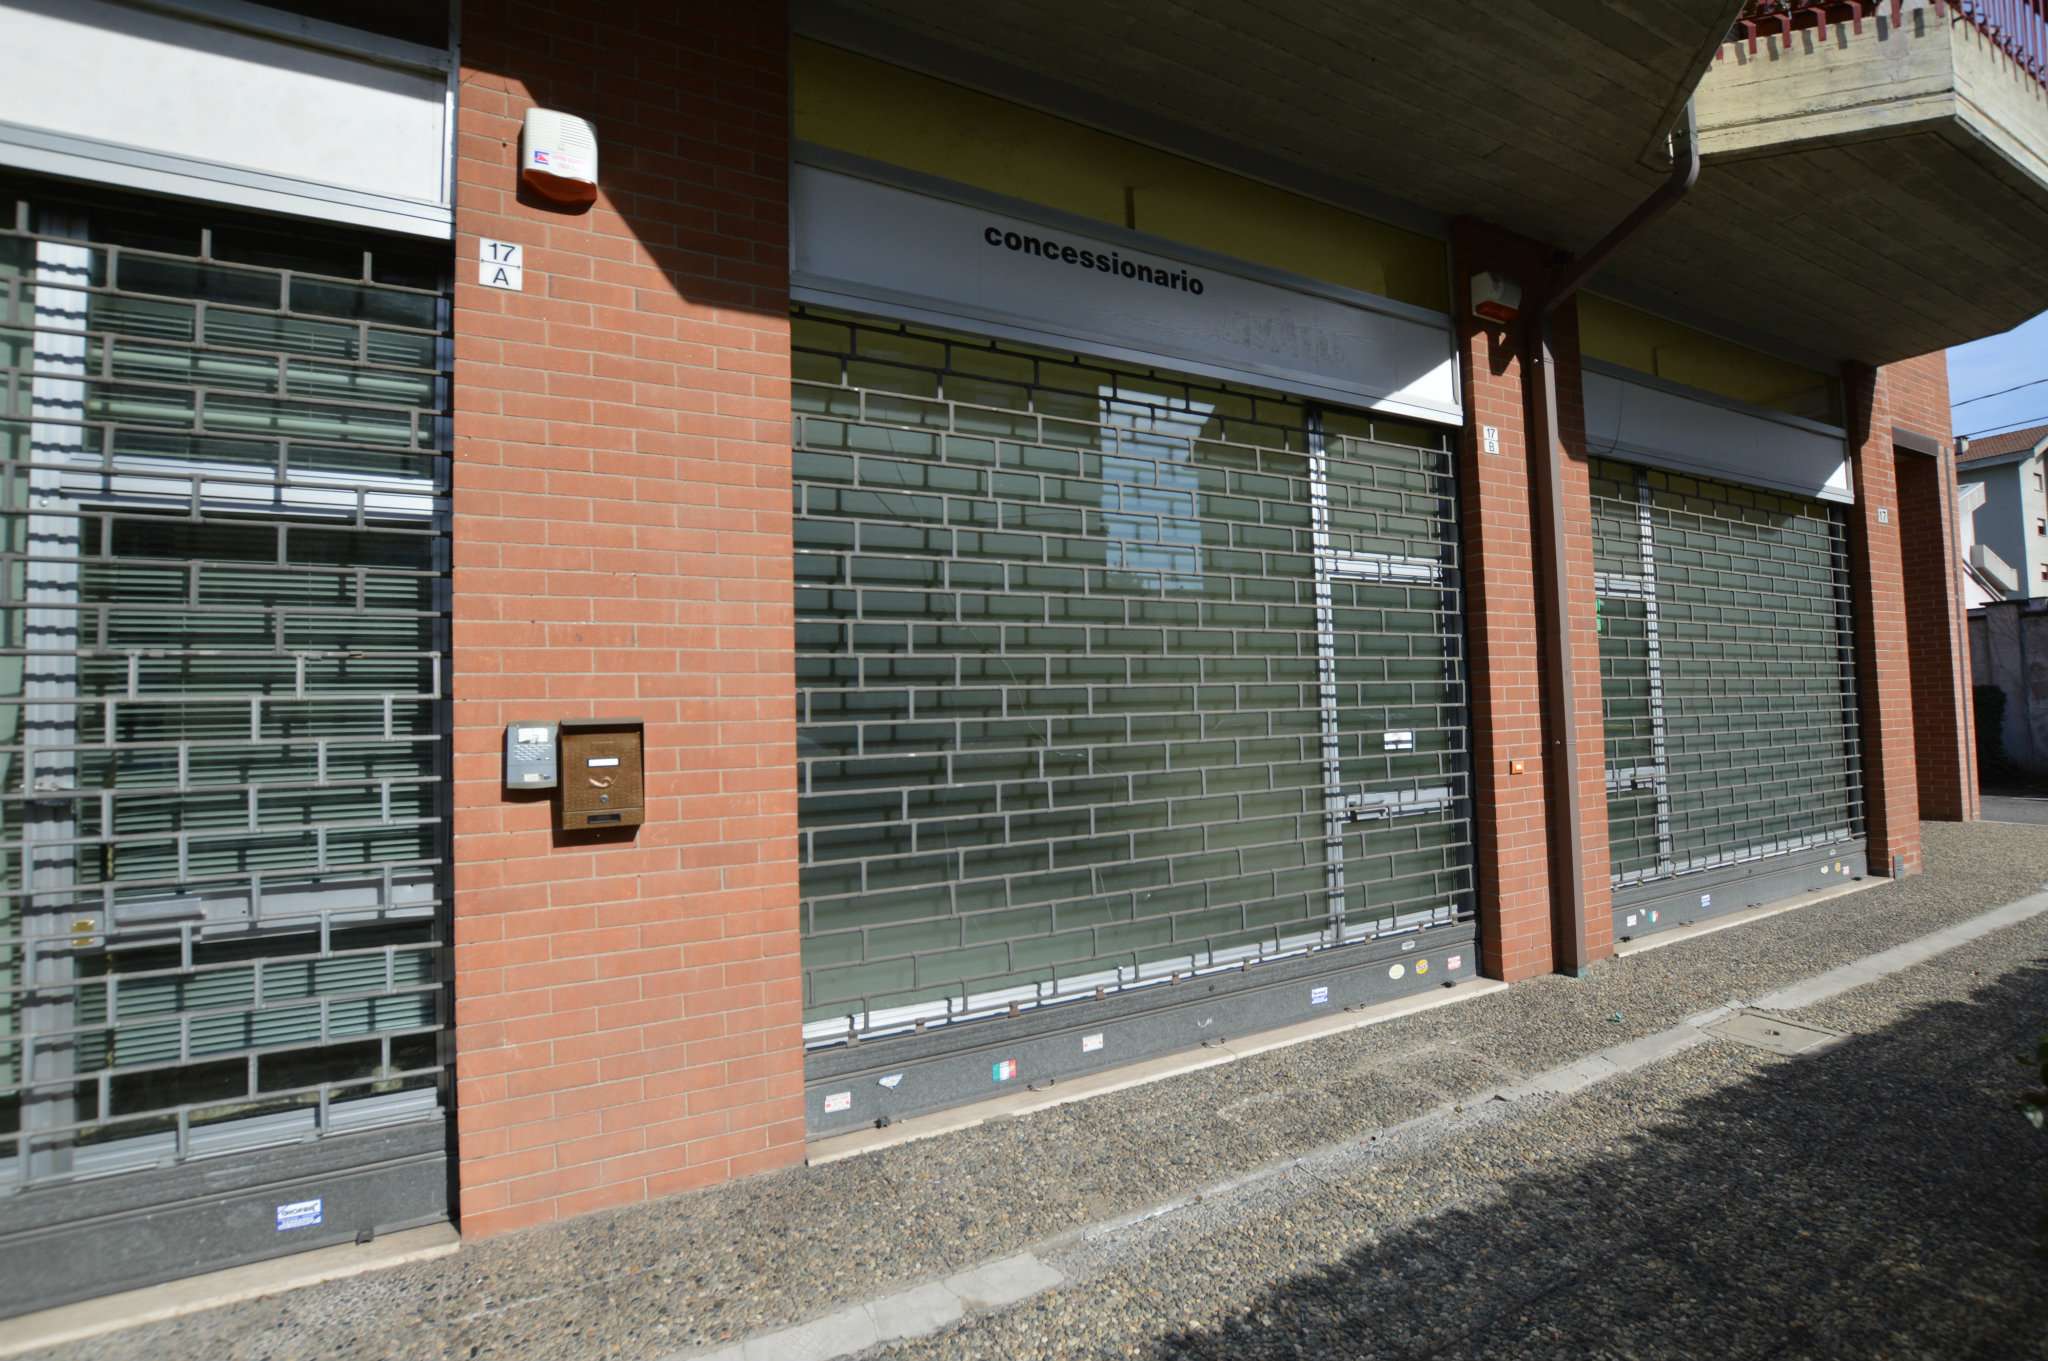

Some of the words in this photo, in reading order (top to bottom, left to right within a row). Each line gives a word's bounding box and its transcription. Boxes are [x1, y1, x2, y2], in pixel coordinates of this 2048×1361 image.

[488, 243, 516, 262] 17
[984, 227, 1204, 295] concessionario
[493, 268, 509, 286] A
[1487, 428, 1496, 439] 17
[1489, 441, 1495, 452] B
[1879, 511, 1886, 521] 17
